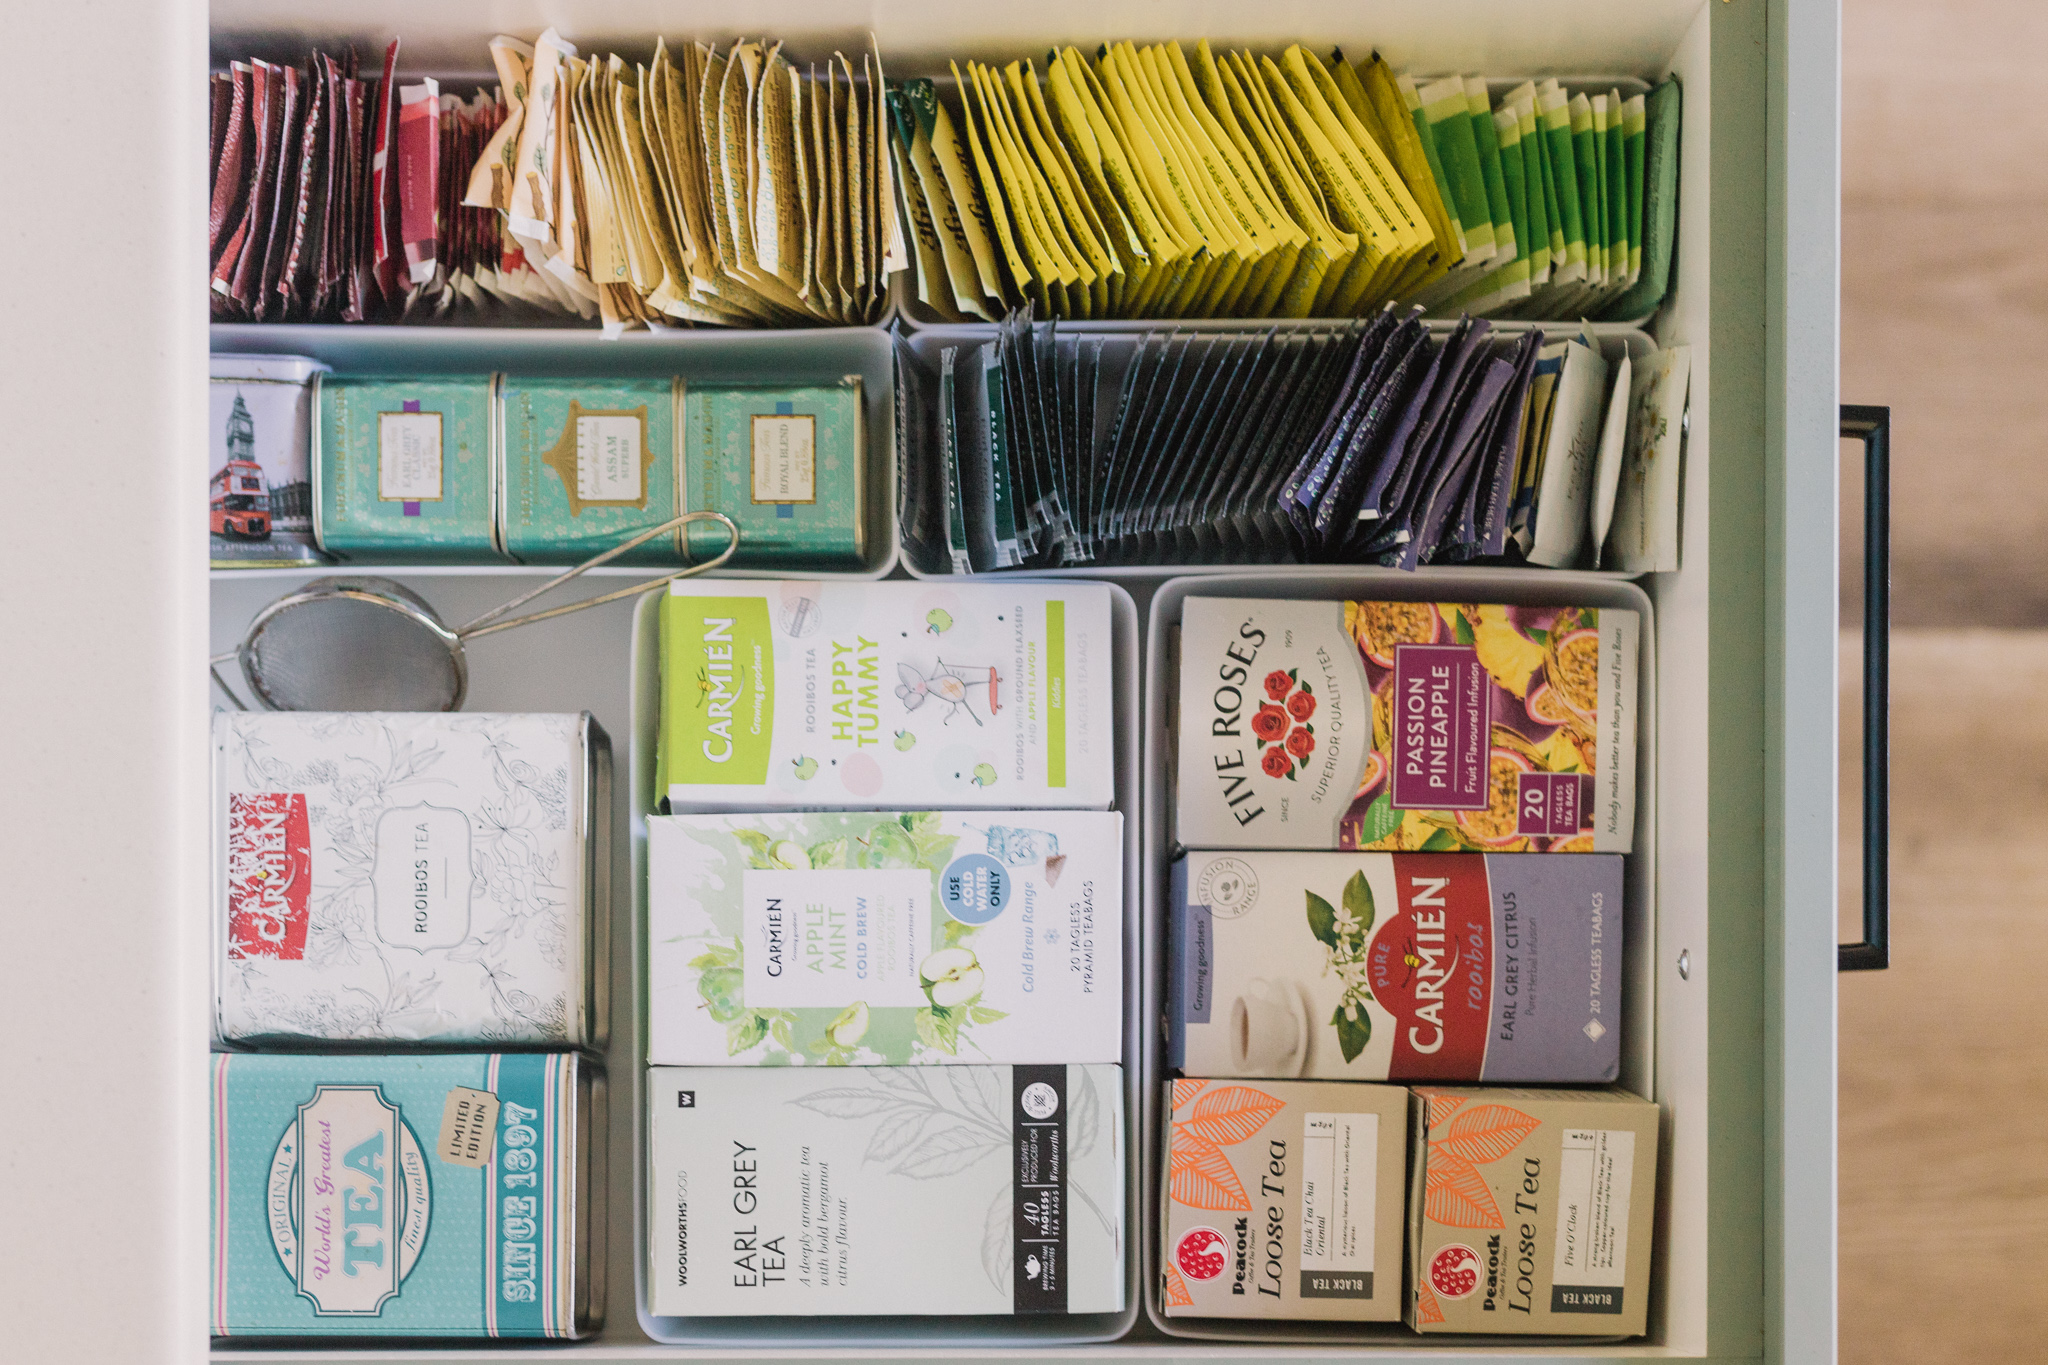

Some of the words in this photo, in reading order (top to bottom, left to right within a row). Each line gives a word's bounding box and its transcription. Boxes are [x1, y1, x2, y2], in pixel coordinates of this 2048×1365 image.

[606, 435, 617, 482] ASSAM
[620, 438, 629, 478] SUPERB
[780, 424, 788, 458] BLEND
[780, 460, 788, 494] ROYAL
[994, 471, 1002, 501] TEA
[1014, 605, 1024, 654] FLAXSEED
[1284, 630, 1293, 648] 1909
[806, 648, 816, 670] TEA
[1028, 641, 1036, 688] FLAVOUR
[1076, 632, 1088, 683] TEABAGS
[1316, 646, 1334, 672] TEA
[1612, 653, 1622, 671] Five
[702, 617, 745, 763] CARMIÉN
[832, 640, 853, 740] HAPPY
[856, 634, 879, 748] TUMMY
[1015, 656, 1024, 702] GROUND
[1052, 676, 1062, 708] Kiddies
[1212, 621, 1266, 737] ROSES
[1466, 662, 1480, 706] Infusion
[1612, 672, 1621, 690] and
[1612, 691, 1624, 709] you
[750, 693, 766, 735] Growing
[806, 674, 816, 733] ROOIBOS
[1028, 691, 1036, 720] APPLE
[1325, 674, 1343, 732] QUALITY
[1610, 710, 1620, 729] than
[1078, 740, 1089, 753] 20
[1406, 676, 1426, 776] PASSION
[1429, 665, 1450, 788] PINEAPPLE
[1465, 709, 1480, 764] Flavoured
[1610, 731, 1620, 744] tea
[1015, 733, 1024, 780] ROOIBOS
[1310, 736, 1342, 804] SUPERIOR
[1608, 745, 1620, 770] better
[1214, 749, 1266, 827] FIVE
[1464, 766, 1478, 794] Fruit
[1564, 782, 1575, 808] BAGS
[1609, 772, 1619, 798] makes
[1280, 797, 1289, 822] SINCE
[1524, 788, 1544, 820] 20
[1555, 784, 1564, 824] TAGLESS
[1564, 809, 1574, 826] TEA
[1608, 800, 1622, 834] Nobody
[415, 822, 429, 853] TEA
[414, 859, 429, 934] ROOIBOS
[950, 876, 960, 900] USE
[962, 870, 974, 907] COLD
[976, 866, 988, 912] WATER
[990, 870, 1000, 906] ONLY
[1022, 882, 1037, 924] Range
[1200, 860, 1234, 904] INFUSION
[1232, 882, 1256, 915] RANGE
[856, 896, 868, 936] BREW
[1070, 902, 1080, 954] TAGLESS
[1082, 880, 1094, 936] TEABAGS
[1502, 891, 1519, 950] CITRUS
[1591, 891, 1603, 946] TEABAGS
[766, 898, 787, 977] CARMIÉN
[806, 903, 824, 974] APPLE
[828, 906, 846, 970] MINT
[1022, 926, 1034, 960] Brew
[1526, 916, 1537, 956] Infusion
[856, 942, 868, 980] COLD
[1021, 963, 1034, 992] Cold
[1070, 956, 1080, 972] 20
[1083, 939, 1094, 993] PYRAMID
[1374, 941, 1390, 988] PURE
[1408, 876, 1460, 1054] CARMIÉN
[1463, 922, 1484, 1011] rooibos
[1504, 954, 1519, 996] GREY
[1526, 958, 1538, 992] Herbal
[1590, 948, 1602, 996] TAGLESS
[1192, 969, 1207, 1011] Growing
[1524, 994, 1536, 1016] Pure
[1590, 999, 1600, 1014] 20
[1500, 1001, 1517, 1042] EARL
[450, 1100, 472, 1156] LIMITED
[466, 1102, 487, 1160] EDITION
[502, 1100, 538, 1190] 1897
[1030, 1128, 1038, 1143] FOR
[313, 1120, 334, 1196] Greatest
[800, 1145, 811, 1166] tea
[1021, 1140, 1030, 1183] EXCLUSIVELY
[1030, 1144, 1038, 1183] PRODUCED
[1049, 1129, 1060, 1182] Woolworths
[1261, 1139, 1287, 1198] Tea
[404, 1151, 428, 1204] quality
[733, 1140, 758, 1214] GREY
[817, 1161, 832, 1222] bergamot
[1304, 1181, 1315, 1205] Chai
[1514, 1156, 1542, 1216] Tea
[271, 1157, 293, 1243] ORIGINAL
[341, 1128, 386, 1278] TEA
[798, 1169, 811, 1228] aromatic
[1022, 1202, 1040, 1226] 40
[1041, 1190, 1050, 1236] TAGLESS
[1052, 1190, 1060, 1214] BAGS
[1303, 1206, 1314, 1224] Tea
[313, 1204, 332, 1280] World's
[404, 1207, 424, 1254] finest
[817, 1226, 830, 1254] bold
[835, 1196, 851, 1248] flavour.
[1052, 1218, 1060, 1236] TEA
[1302, 1228, 1314, 1256] Black
[1316, 1216, 1327, 1256] Oriental
[1566, 1204, 1578, 1244] O'Clock
[502, 1194, 538, 1303] SINCE
[733, 1224, 758, 1287] EARL
[762, 1235, 786, 1288] TEA
[798, 1230, 814, 1274] deeply
[836, 1248, 848, 1286] citrus
[1232, 1216, 1248, 1296] Peacock
[1258, 1206, 1284, 1300] Loose
[1508, 1223, 1536, 1315] Loose
[1564, 1246, 1576, 1266] Five
[799, 1276, 811, 1287] A
[817, 1258, 830, 1286] with
[1312, 1278, 1330, 1290] TEA
[1332, 1278, 1364, 1290] BLACK
[1482, 1234, 1500, 1311] Peacock
[1562, 1292, 1580, 1304] TEA
[1582, 1293, 1613, 1306] BLACK
